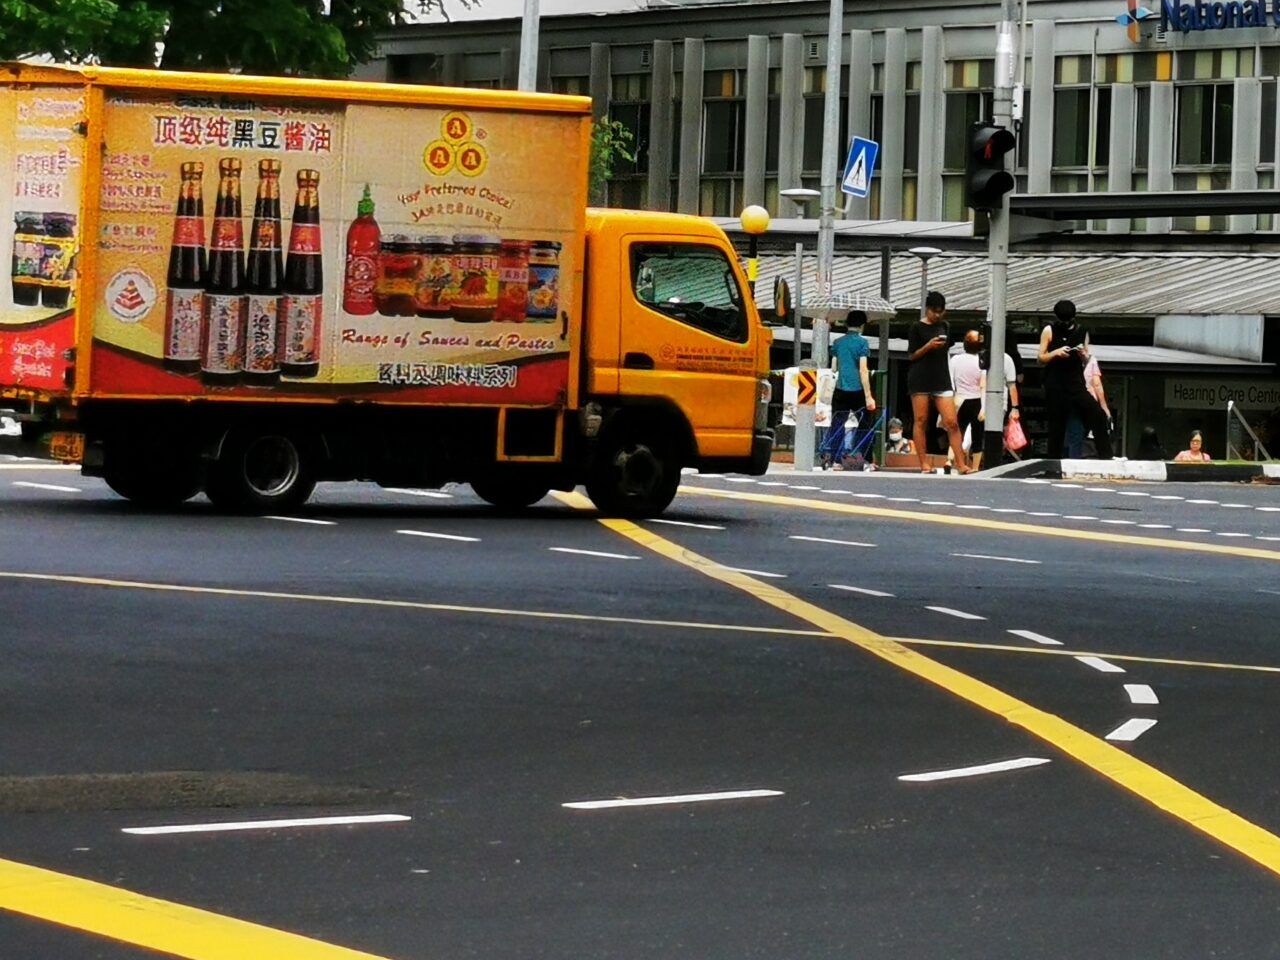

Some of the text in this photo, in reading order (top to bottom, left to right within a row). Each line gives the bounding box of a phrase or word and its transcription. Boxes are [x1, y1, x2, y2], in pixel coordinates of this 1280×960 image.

[342, 329, 555, 351] Range of Sauces and Pastes
[1173, 383, 1215, 405] Hearing
[1218, 385, 1245, 402] Care
